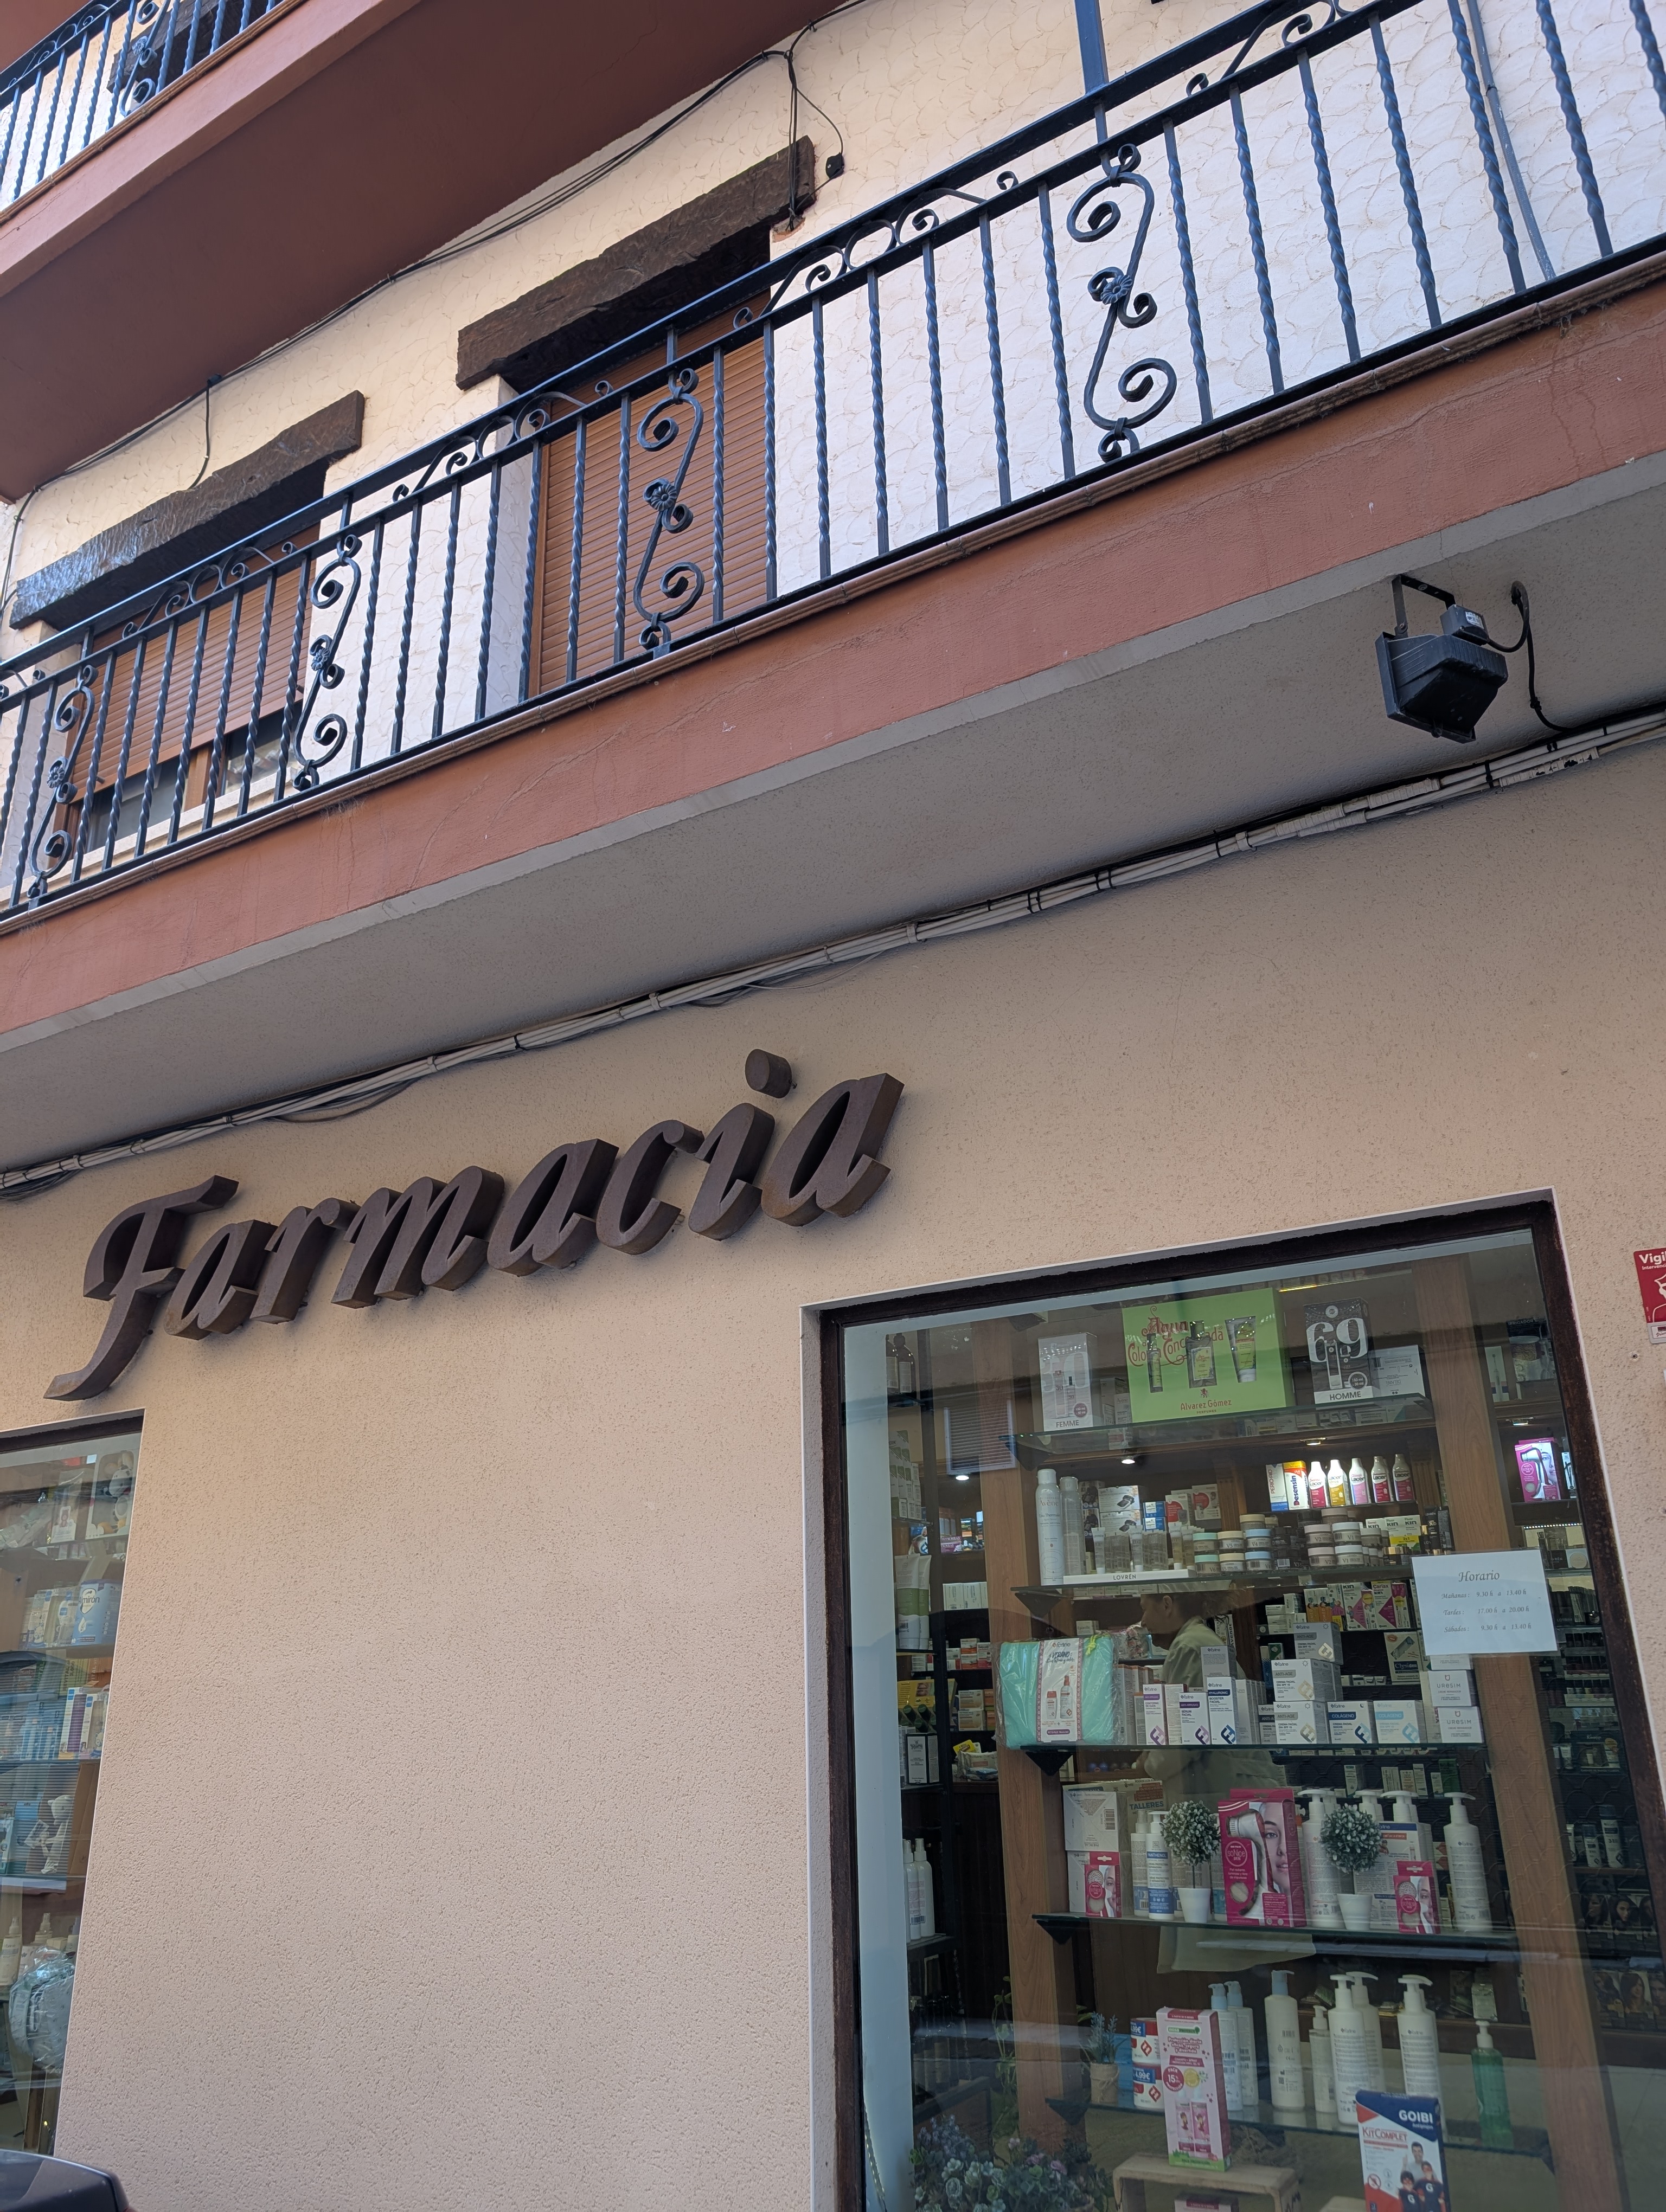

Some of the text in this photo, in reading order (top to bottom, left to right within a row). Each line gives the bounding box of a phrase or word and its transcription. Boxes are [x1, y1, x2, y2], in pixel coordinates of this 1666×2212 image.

[43, 1049, 905, 1401] Farmacia
[1141, 1306, 1189, 1340] Agua
[1306, 1318, 1368, 1362] 69
[1330, 1391, 1362, 1401] HOMME
[1181, 1399, 1232, 1411] Alvarez Gómez
[1056, 1419, 1079, 1428] FEMME
[1291, 1475, 1300, 1506] Desensin
[1458, 1570, 1500, 1582] Horario
[1130, 1801, 1164, 1810] TALLERES
[1227, 1849, 1245, 1857] soNice
[1399, 2109, 1433, 2124] GOIBI
